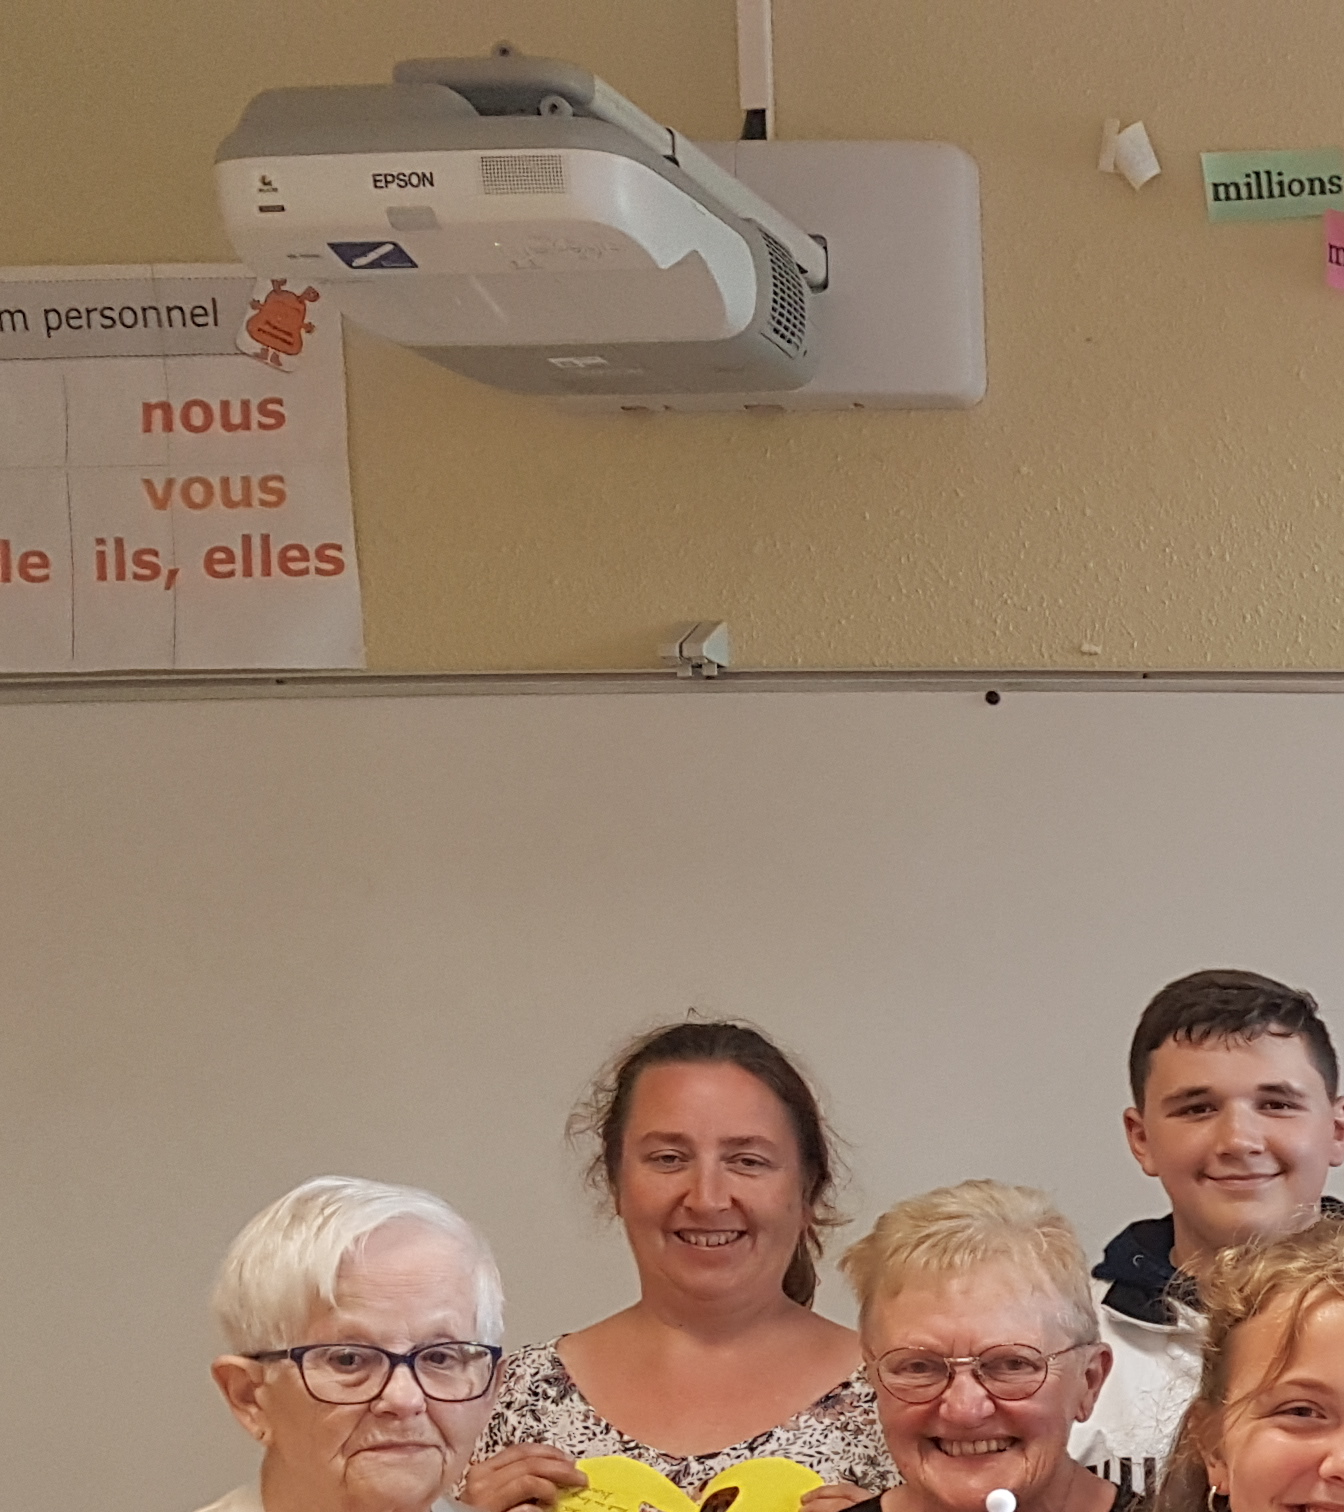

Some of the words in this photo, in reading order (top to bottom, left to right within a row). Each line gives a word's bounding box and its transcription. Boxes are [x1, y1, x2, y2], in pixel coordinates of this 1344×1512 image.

[371, 171, 435, 190] EPSON
[1210, 170, 1344, 203] millions
[43, 296, 220, 339] personnel
[141, 395, 287, 434] nous
[141, 473, 288, 512] vous
[94, 535, 181, 592] ils,
[202, 532, 346, 580] elles
